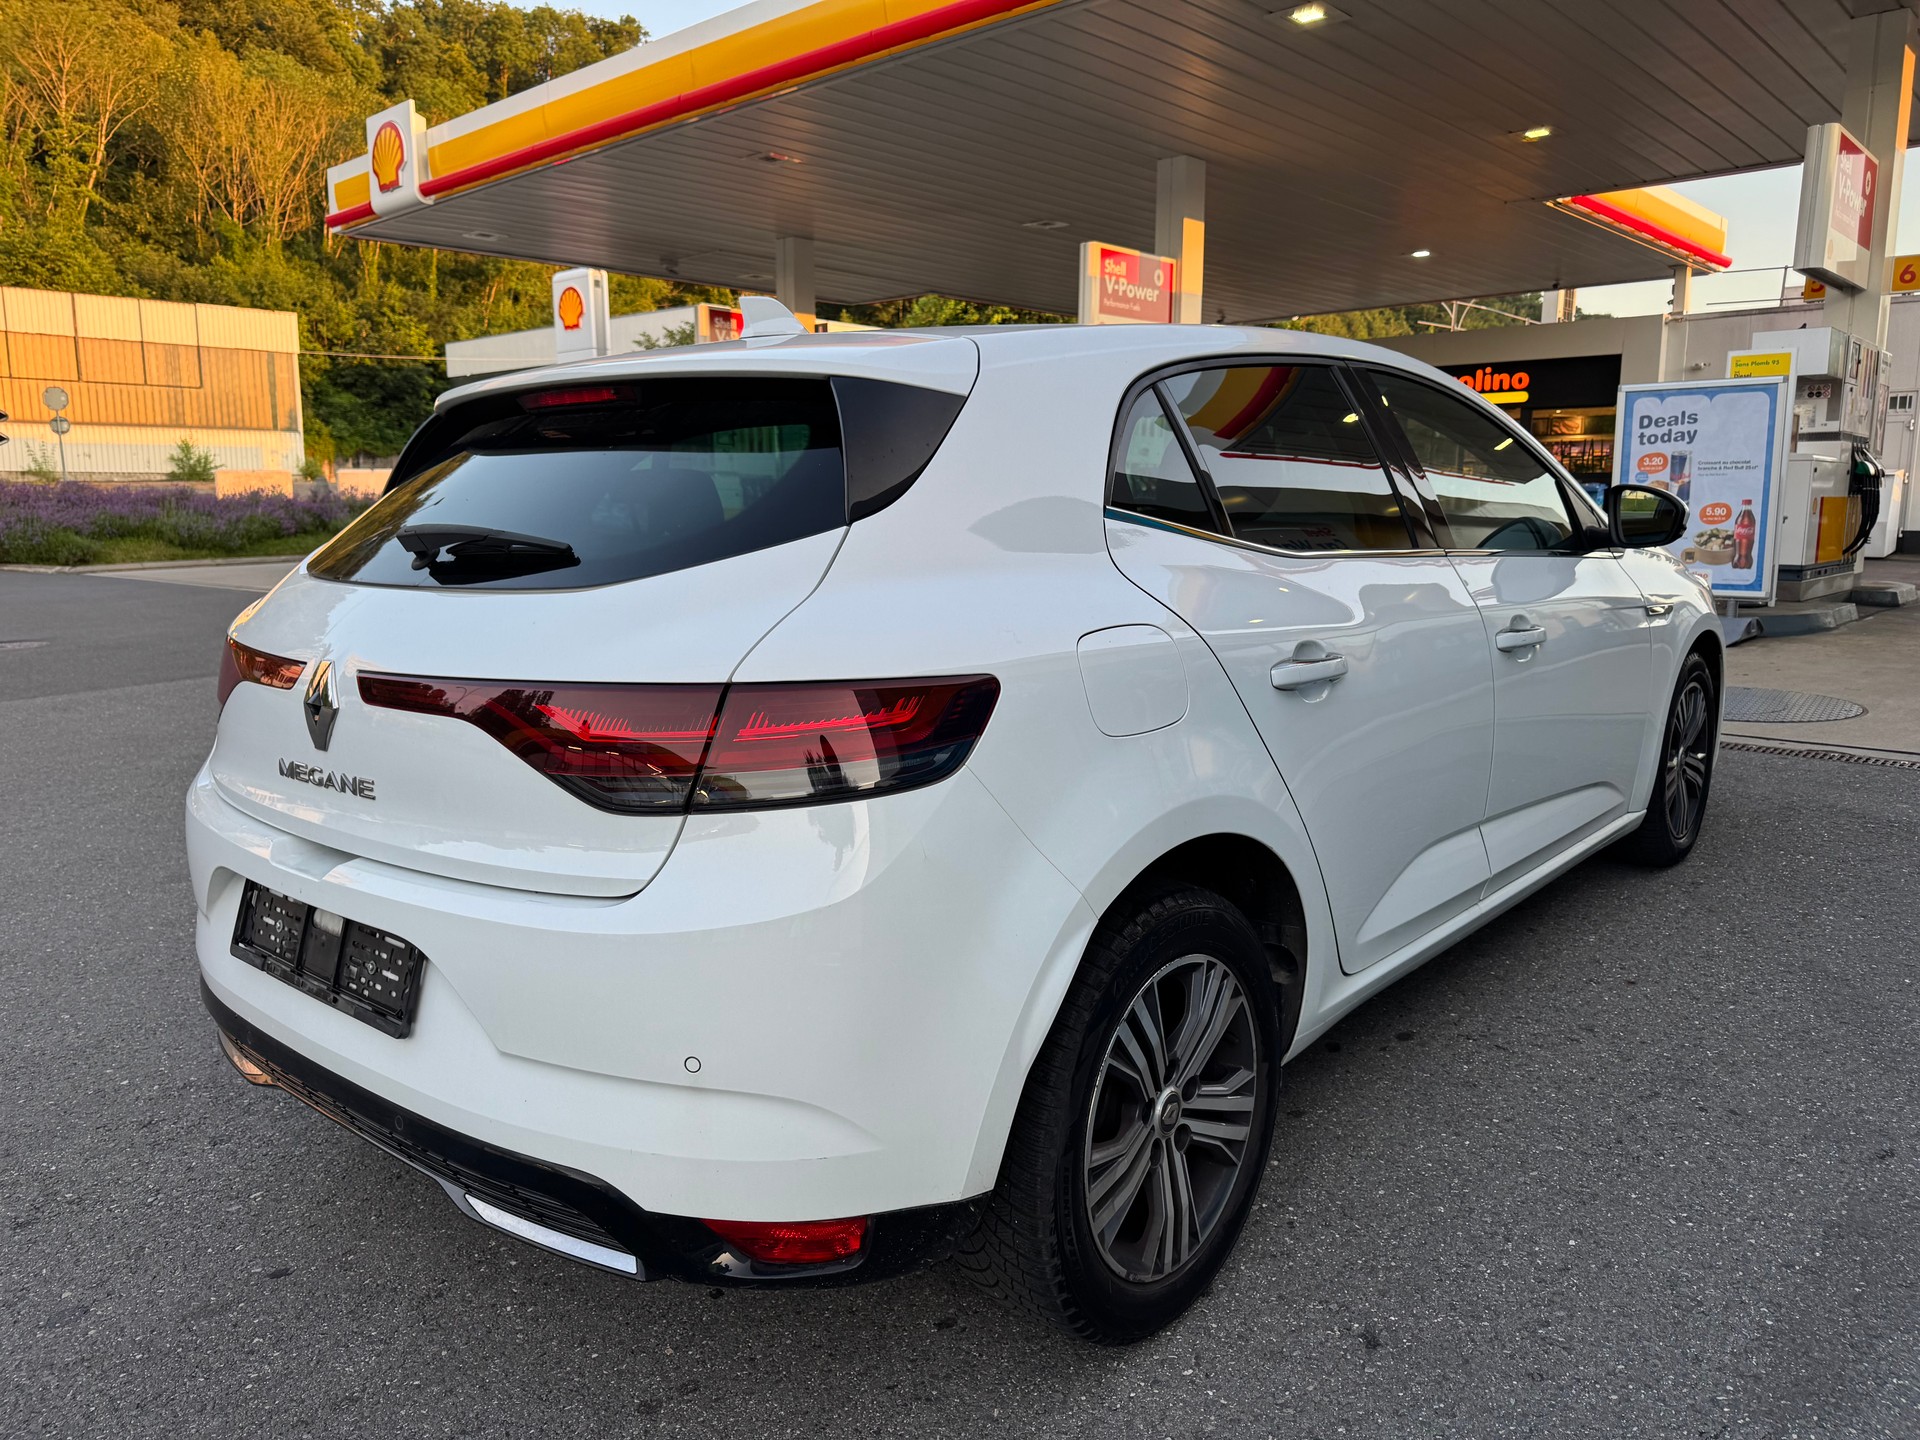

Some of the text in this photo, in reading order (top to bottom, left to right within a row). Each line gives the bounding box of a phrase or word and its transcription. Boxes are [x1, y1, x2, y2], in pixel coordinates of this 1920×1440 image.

[1105, 258, 1127, 276] Shell
[1899, 264, 1916, 284] 6
[1105, 275, 1159, 302] V-Power
[1456, 366, 1530, 391] olino
[1639, 411, 1698, 430] Deals
[1638, 429, 1698, 446] today
[1643, 456, 1664, 466] 3.20
[1705, 507, 1727, 516] 5.90
[278, 757, 377, 800] MEGANE
